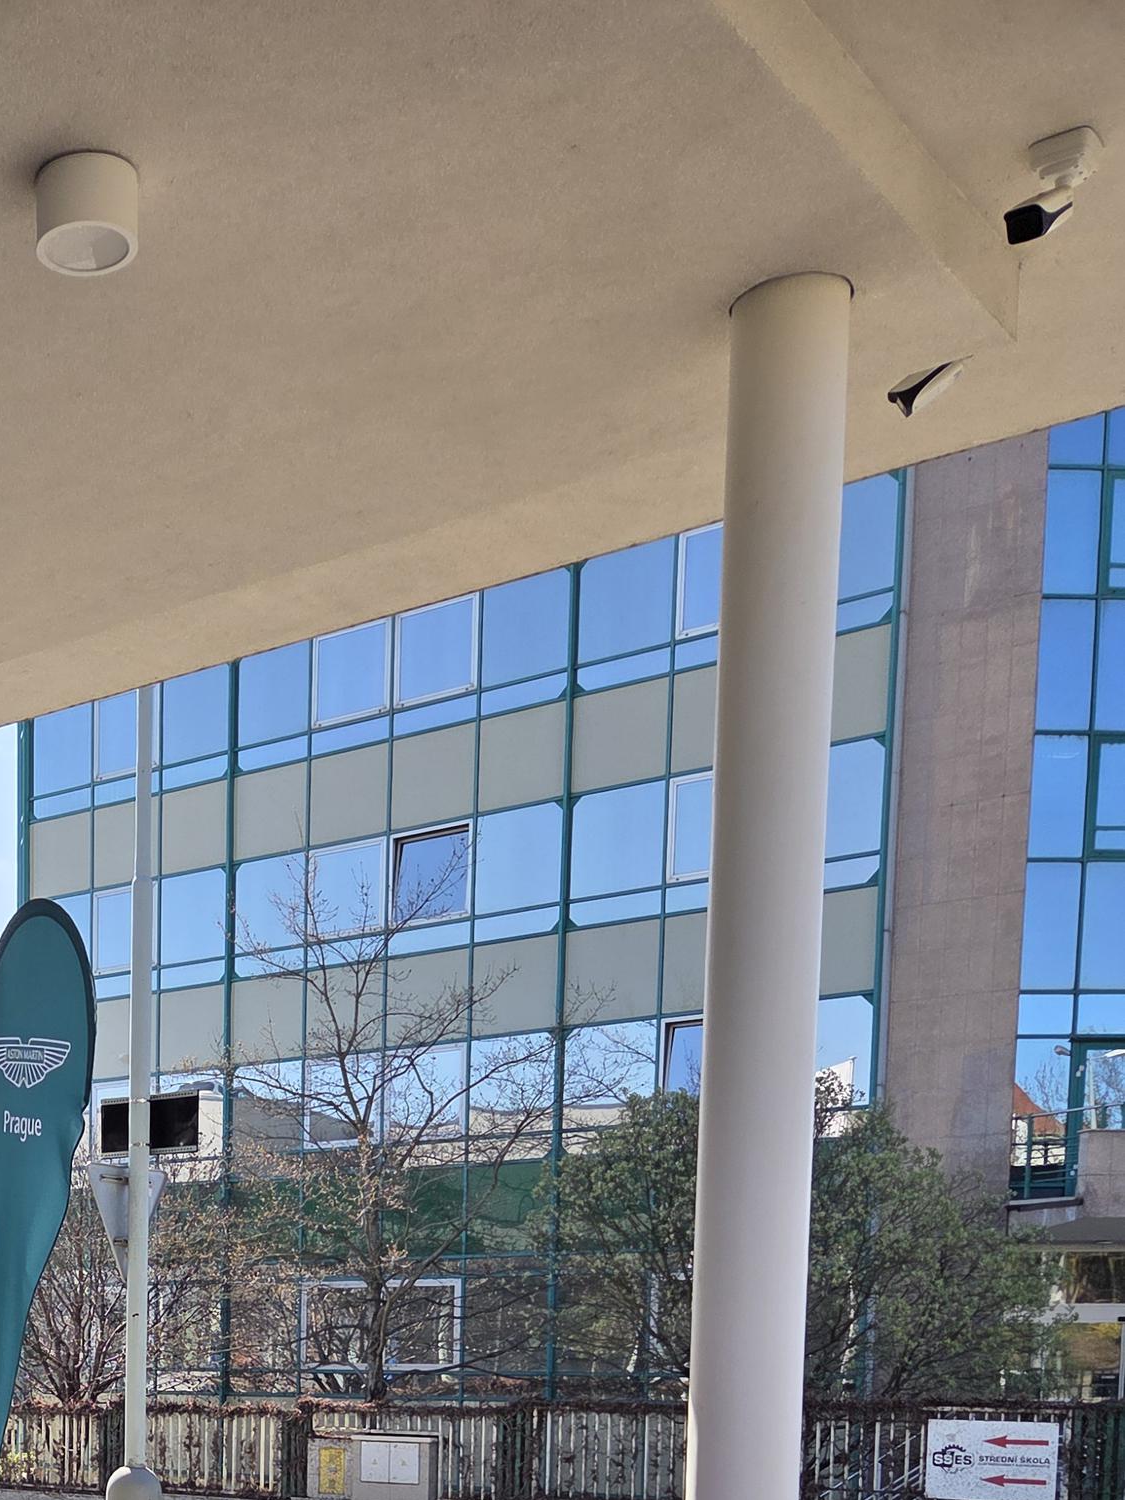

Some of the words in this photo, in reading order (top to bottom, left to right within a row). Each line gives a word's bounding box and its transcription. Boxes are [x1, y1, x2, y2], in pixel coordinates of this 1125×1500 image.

[7, 1048, 23, 1060] ASTON
[23, 1050, 43, 1061] MARTIN
[3, 1110, 42, 1142] Prague
